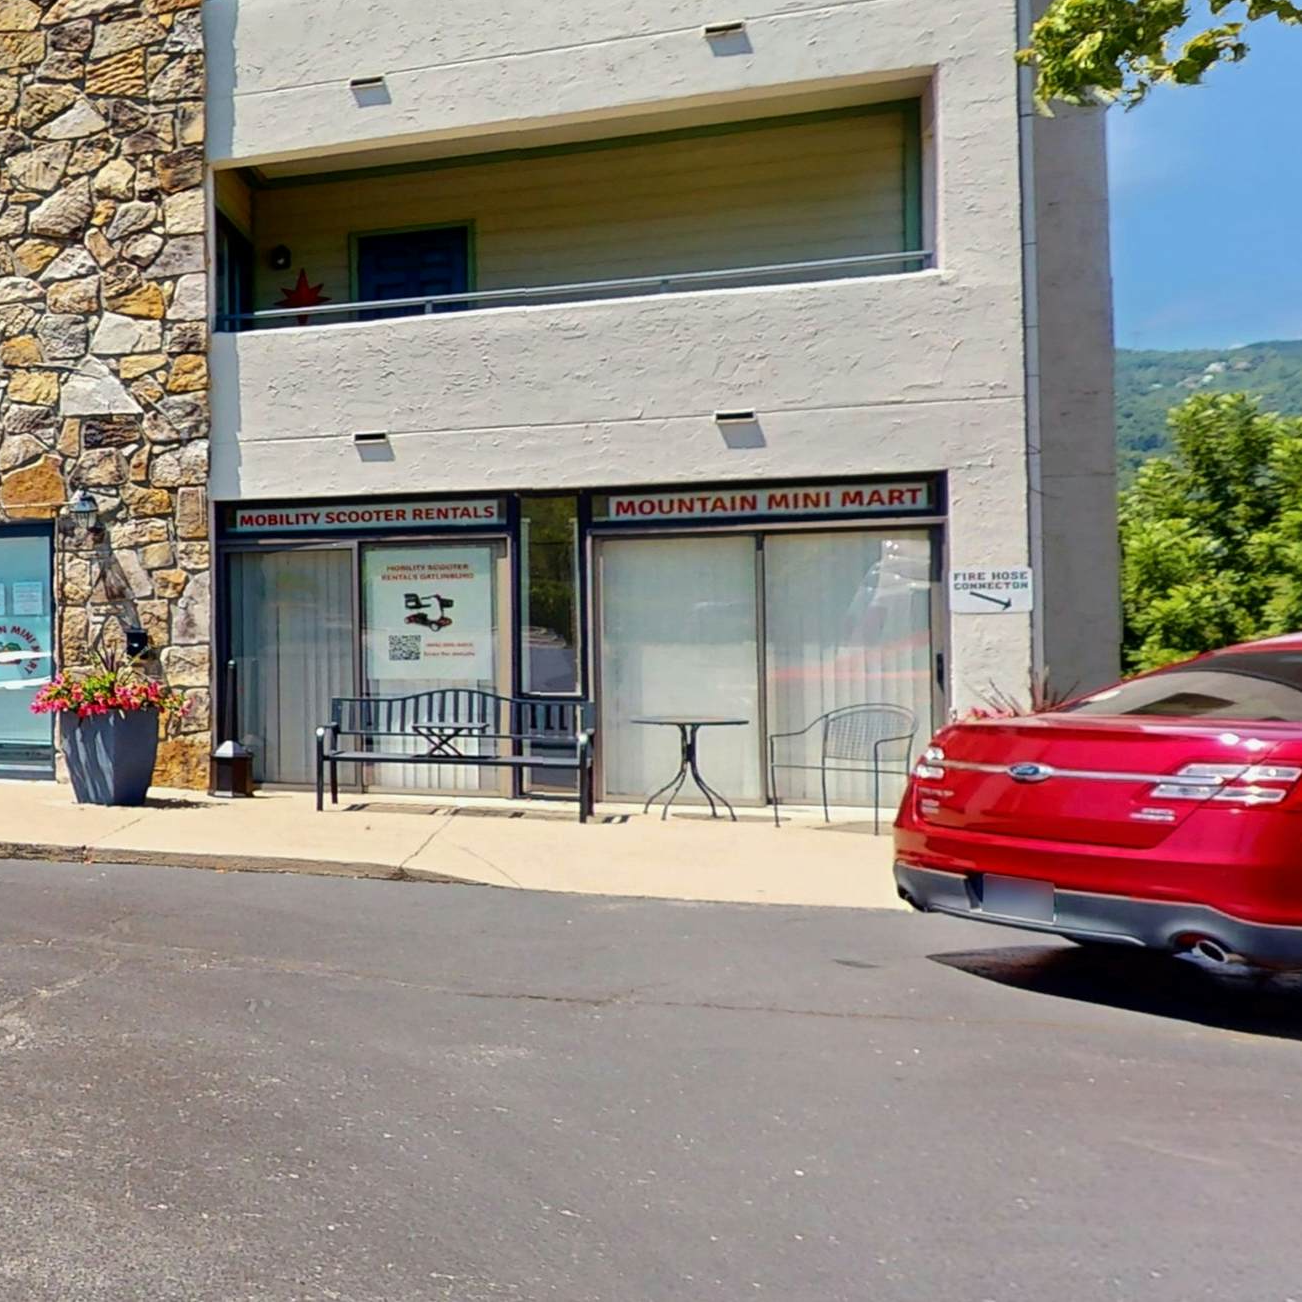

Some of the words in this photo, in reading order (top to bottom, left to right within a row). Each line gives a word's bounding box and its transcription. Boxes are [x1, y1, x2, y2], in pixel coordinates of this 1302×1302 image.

[615, 495, 757, 517] MOUNTAIN
[767, 491, 831, 511] MINI
[840, 488, 922, 508] MART
[239, 511, 321, 527] MOBILITY
[324, 508, 407, 524] SCOOTER
[412, 505, 495, 521] RENTALS
[953, 572, 986, 581] FIRE
[991, 571, 1028, 580] HOSE
[10, 625, 37, 644] MINI
